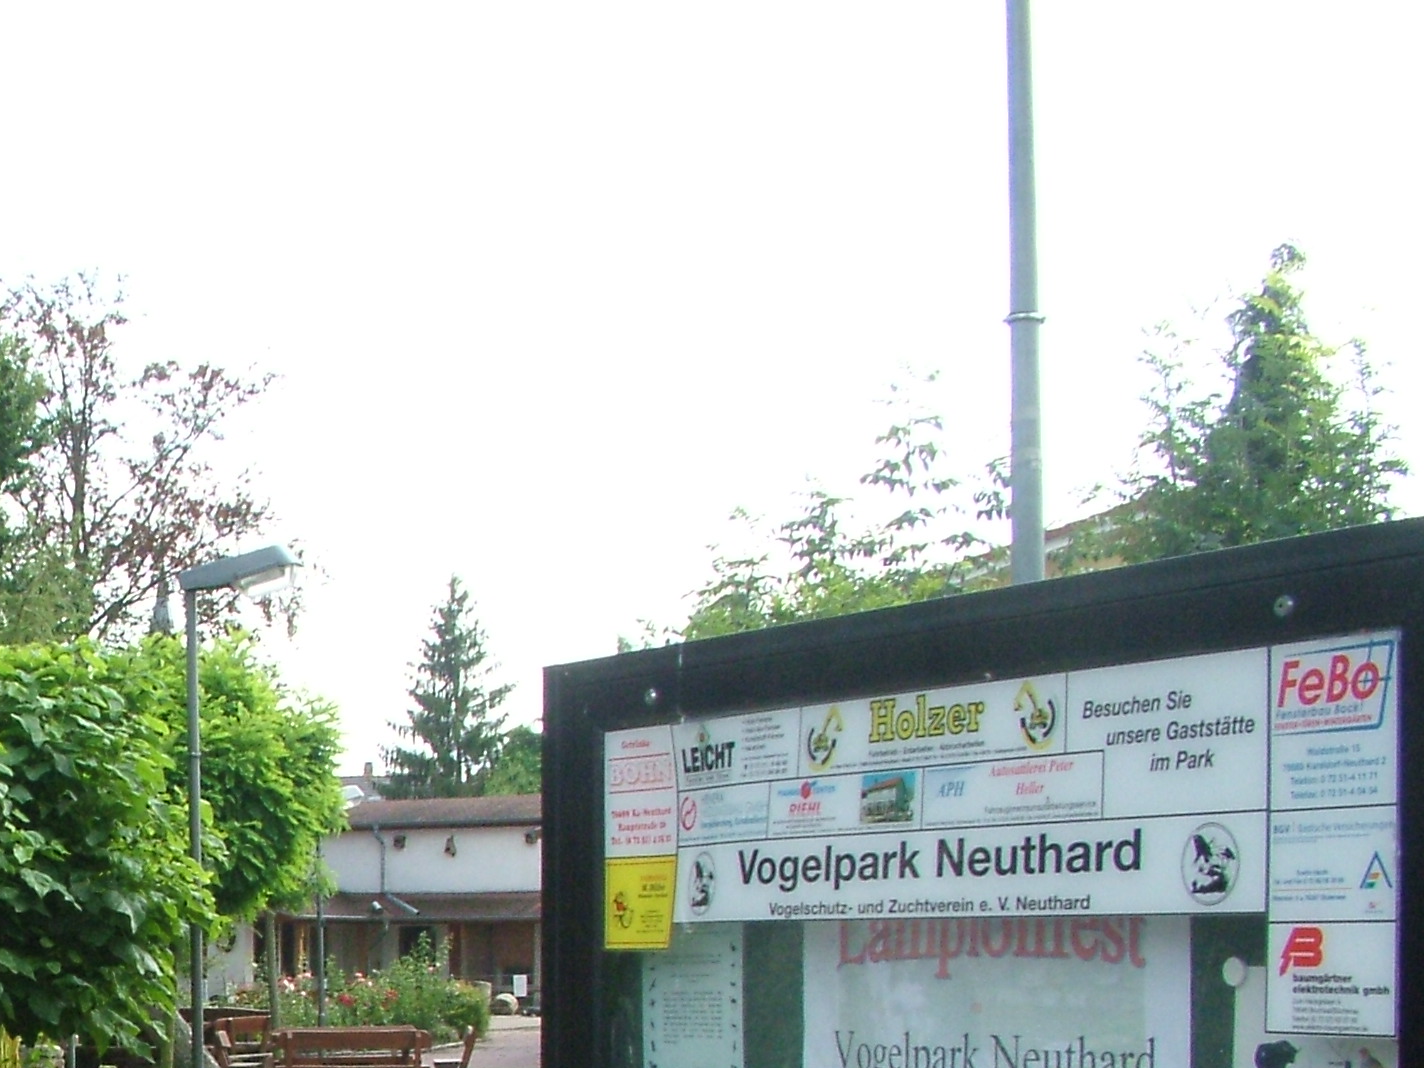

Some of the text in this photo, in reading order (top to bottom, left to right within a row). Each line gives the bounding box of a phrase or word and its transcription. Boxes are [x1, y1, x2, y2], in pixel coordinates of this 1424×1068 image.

[1277, 654, 1379, 707] FeBo
[1082, 690, 1192, 719] Besuchen Sie
[869, 694, 984, 743] Holzer
[1106, 716, 1255, 746] unsere Gaststätte
[682, 741, 735, 773] LEICHT
[1049, 759, 1074, 773] Peter
[1150, 749, 1215, 772] im Park
[610, 761, 673, 787] BOHN
[938, 780, 965, 798] APH
[1015, 782, 1045, 796] Heller
[738, 828, 1142, 893] Vogelpark Neuthard
[769, 895, 1091, 918] Vogelschutz- und Zuchtverein e. V. Neuthard
[1292, 985, 1360, 995] elektrotechnik
